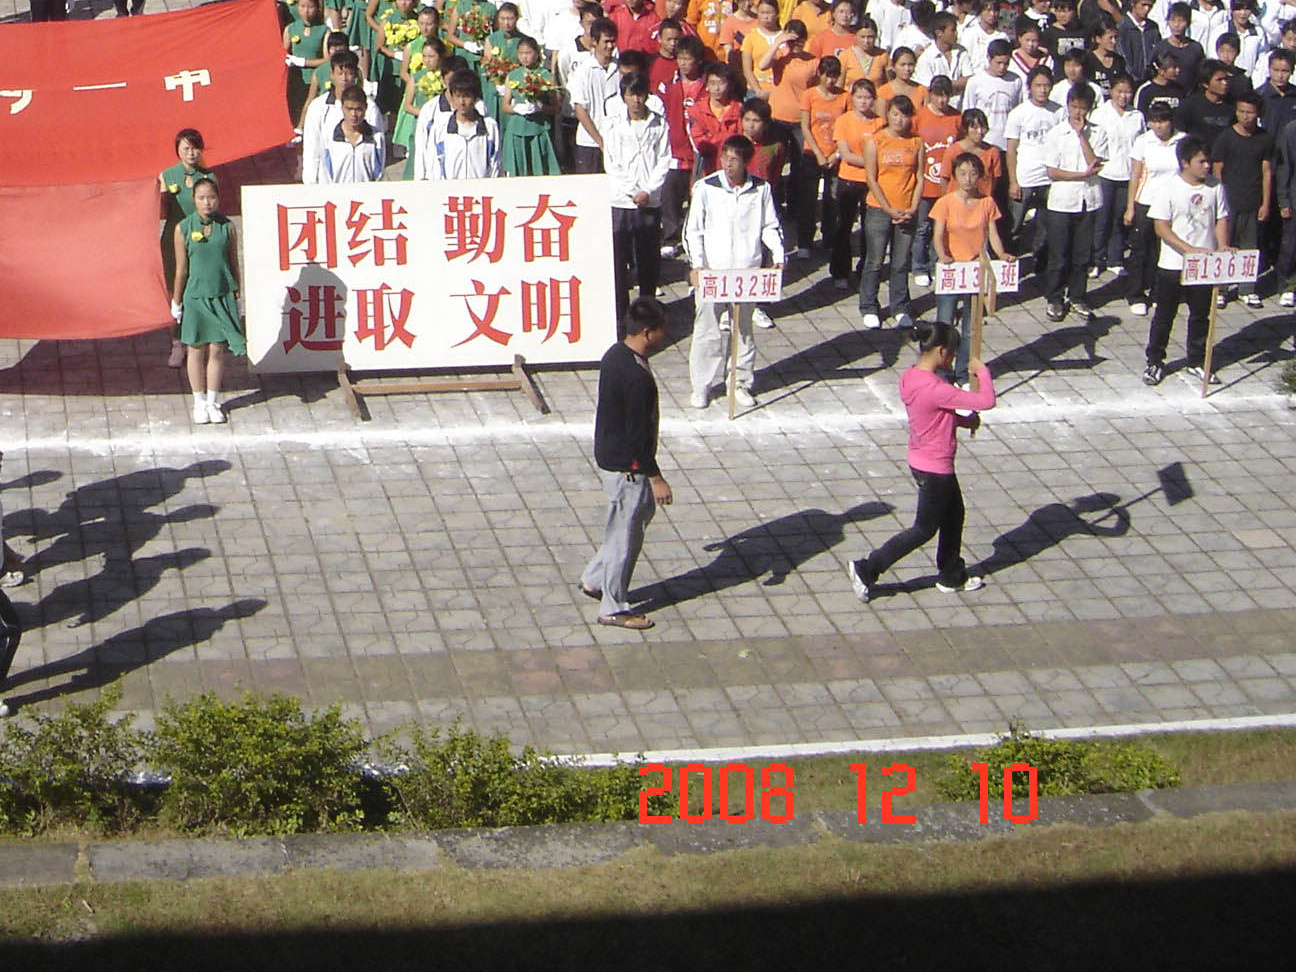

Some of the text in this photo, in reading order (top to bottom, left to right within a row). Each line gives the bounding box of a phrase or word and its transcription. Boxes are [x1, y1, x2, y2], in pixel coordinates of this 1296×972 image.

[277, 193, 578, 271] 团结 勤奋
[942, 264, 1017, 290] 高13班
[1185, 253, 1256, 280] 高136班
[703, 273, 777, 299] 高132班
[280, 275, 582, 355] 进取 文明
